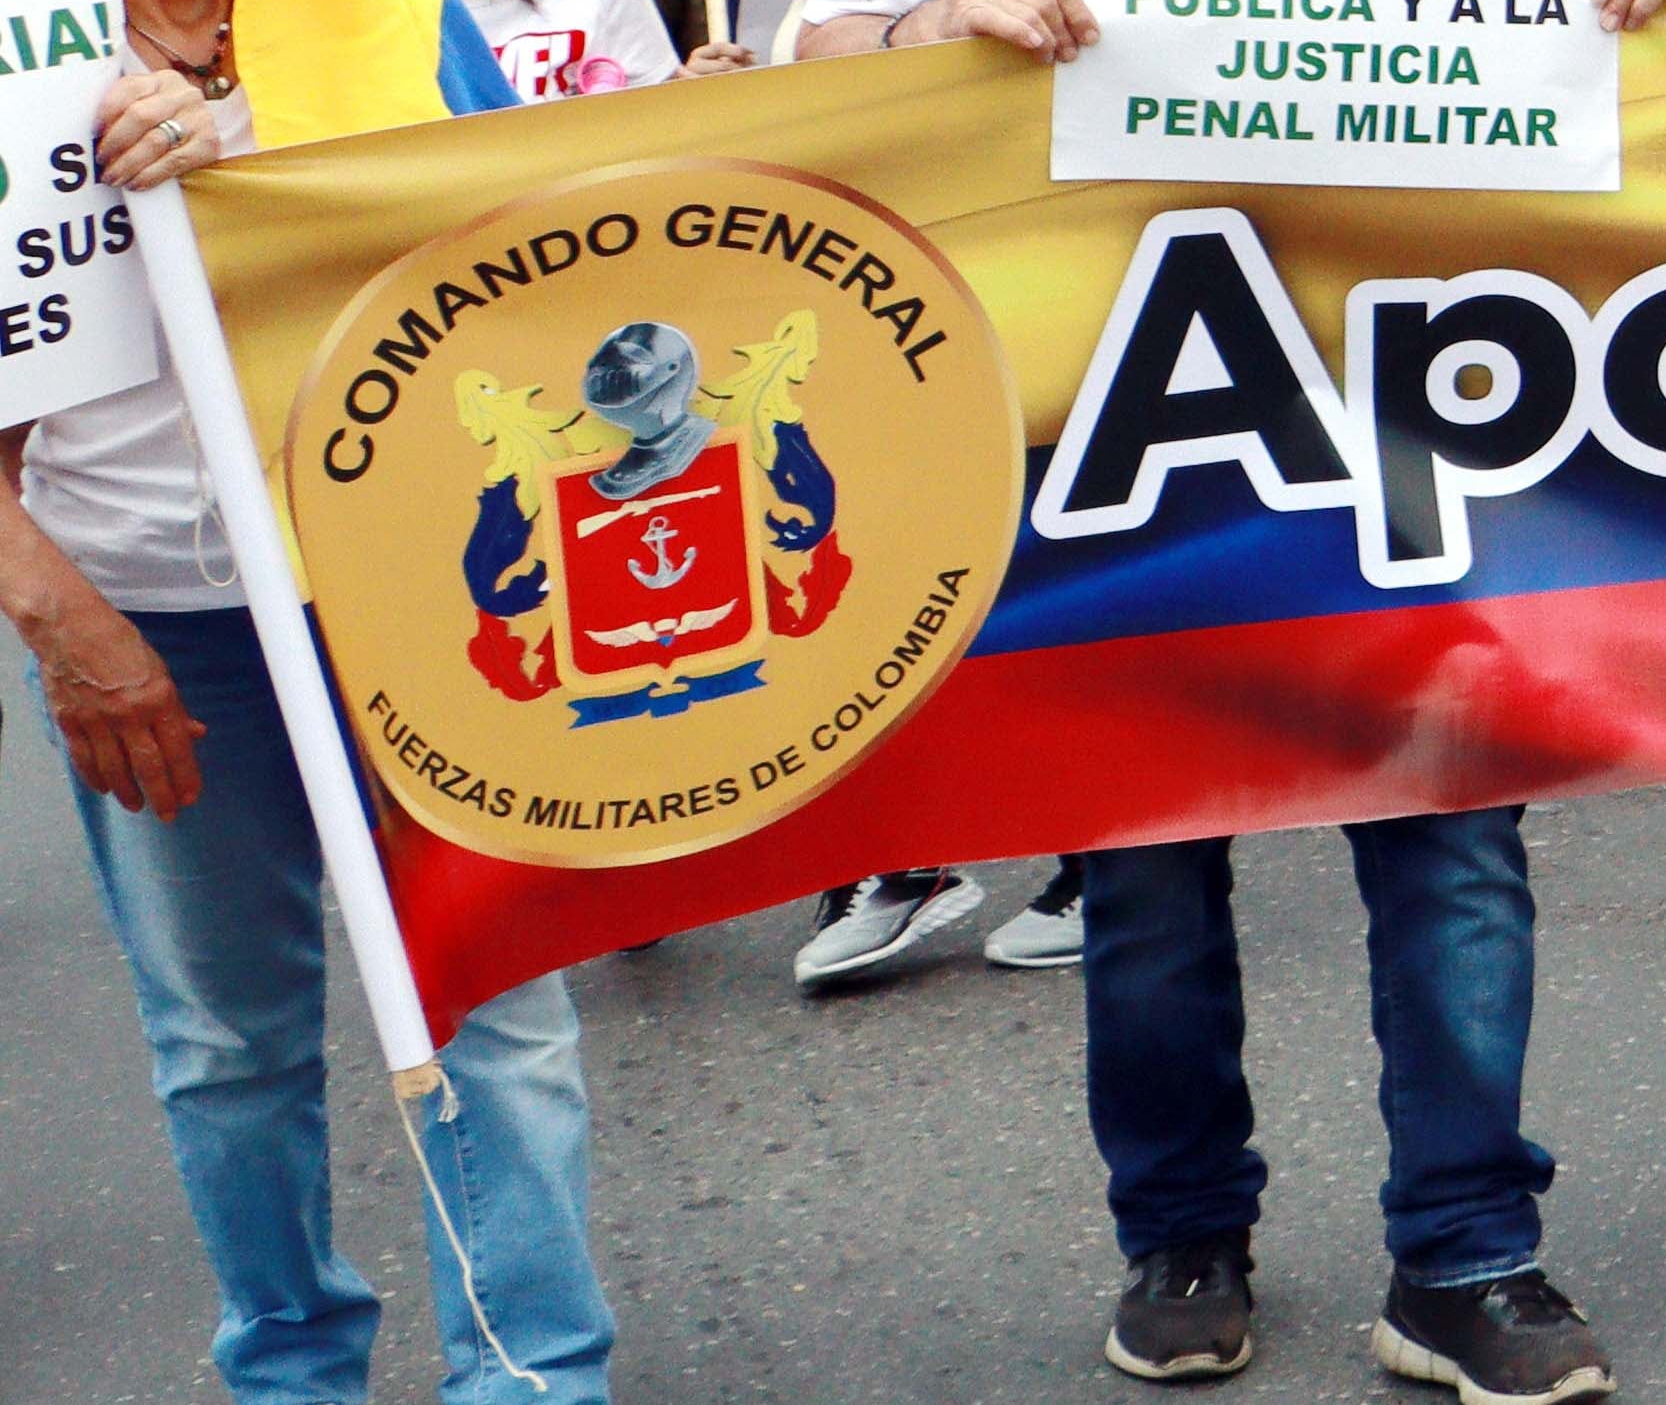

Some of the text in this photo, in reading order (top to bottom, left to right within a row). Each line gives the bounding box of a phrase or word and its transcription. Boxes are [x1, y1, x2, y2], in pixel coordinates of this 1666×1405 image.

[1216, 40, 1481, 86] JUSTICIA
[1125, 96, 1559, 148] PENAL MILITAR
[17, 205, 135, 279] SUS
[322, 202, 949, 483] COMANDO GENERAL
[366, 563, 972, 831] FUERZAS MILITARES DE COLOMBIA
